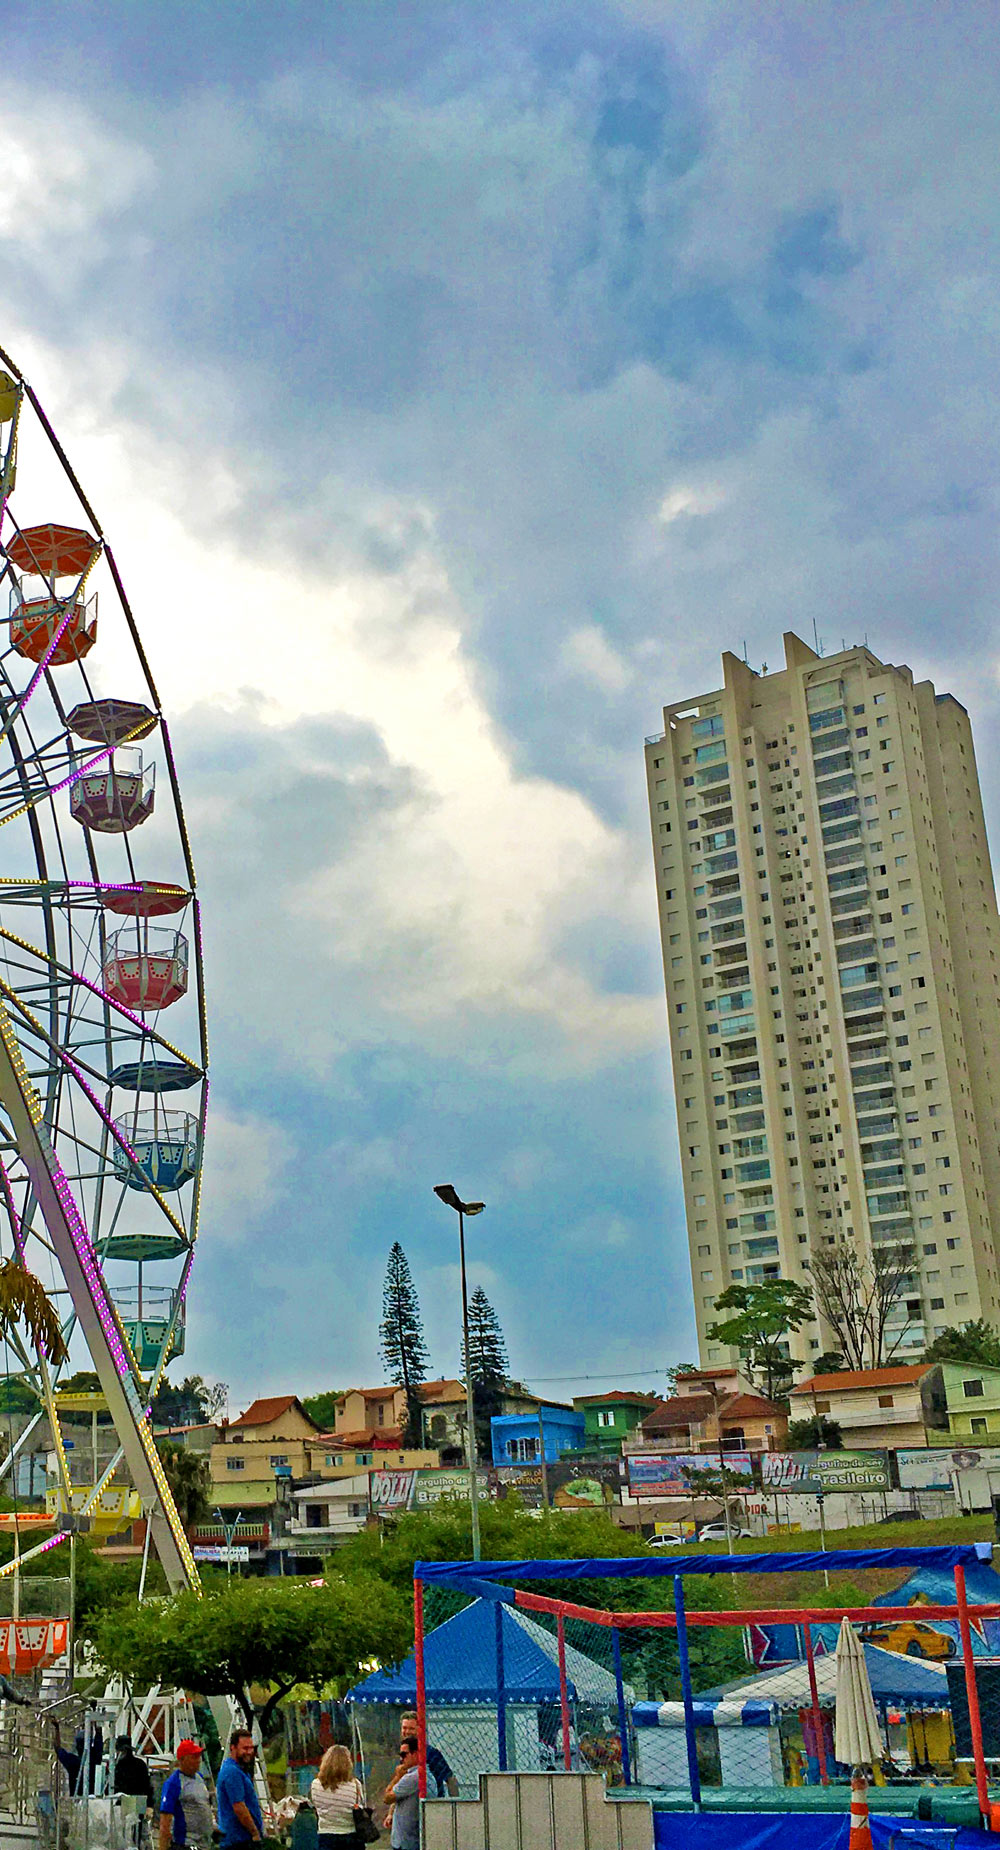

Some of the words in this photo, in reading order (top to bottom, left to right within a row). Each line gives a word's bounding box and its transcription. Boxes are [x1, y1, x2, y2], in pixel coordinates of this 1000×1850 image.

[866, 1458, 883, 1467] ser
[418, 1477, 454, 1487] orgulho
[456, 1477, 468, 1485] de
[811, 1472, 886, 1485] Brasileiro
